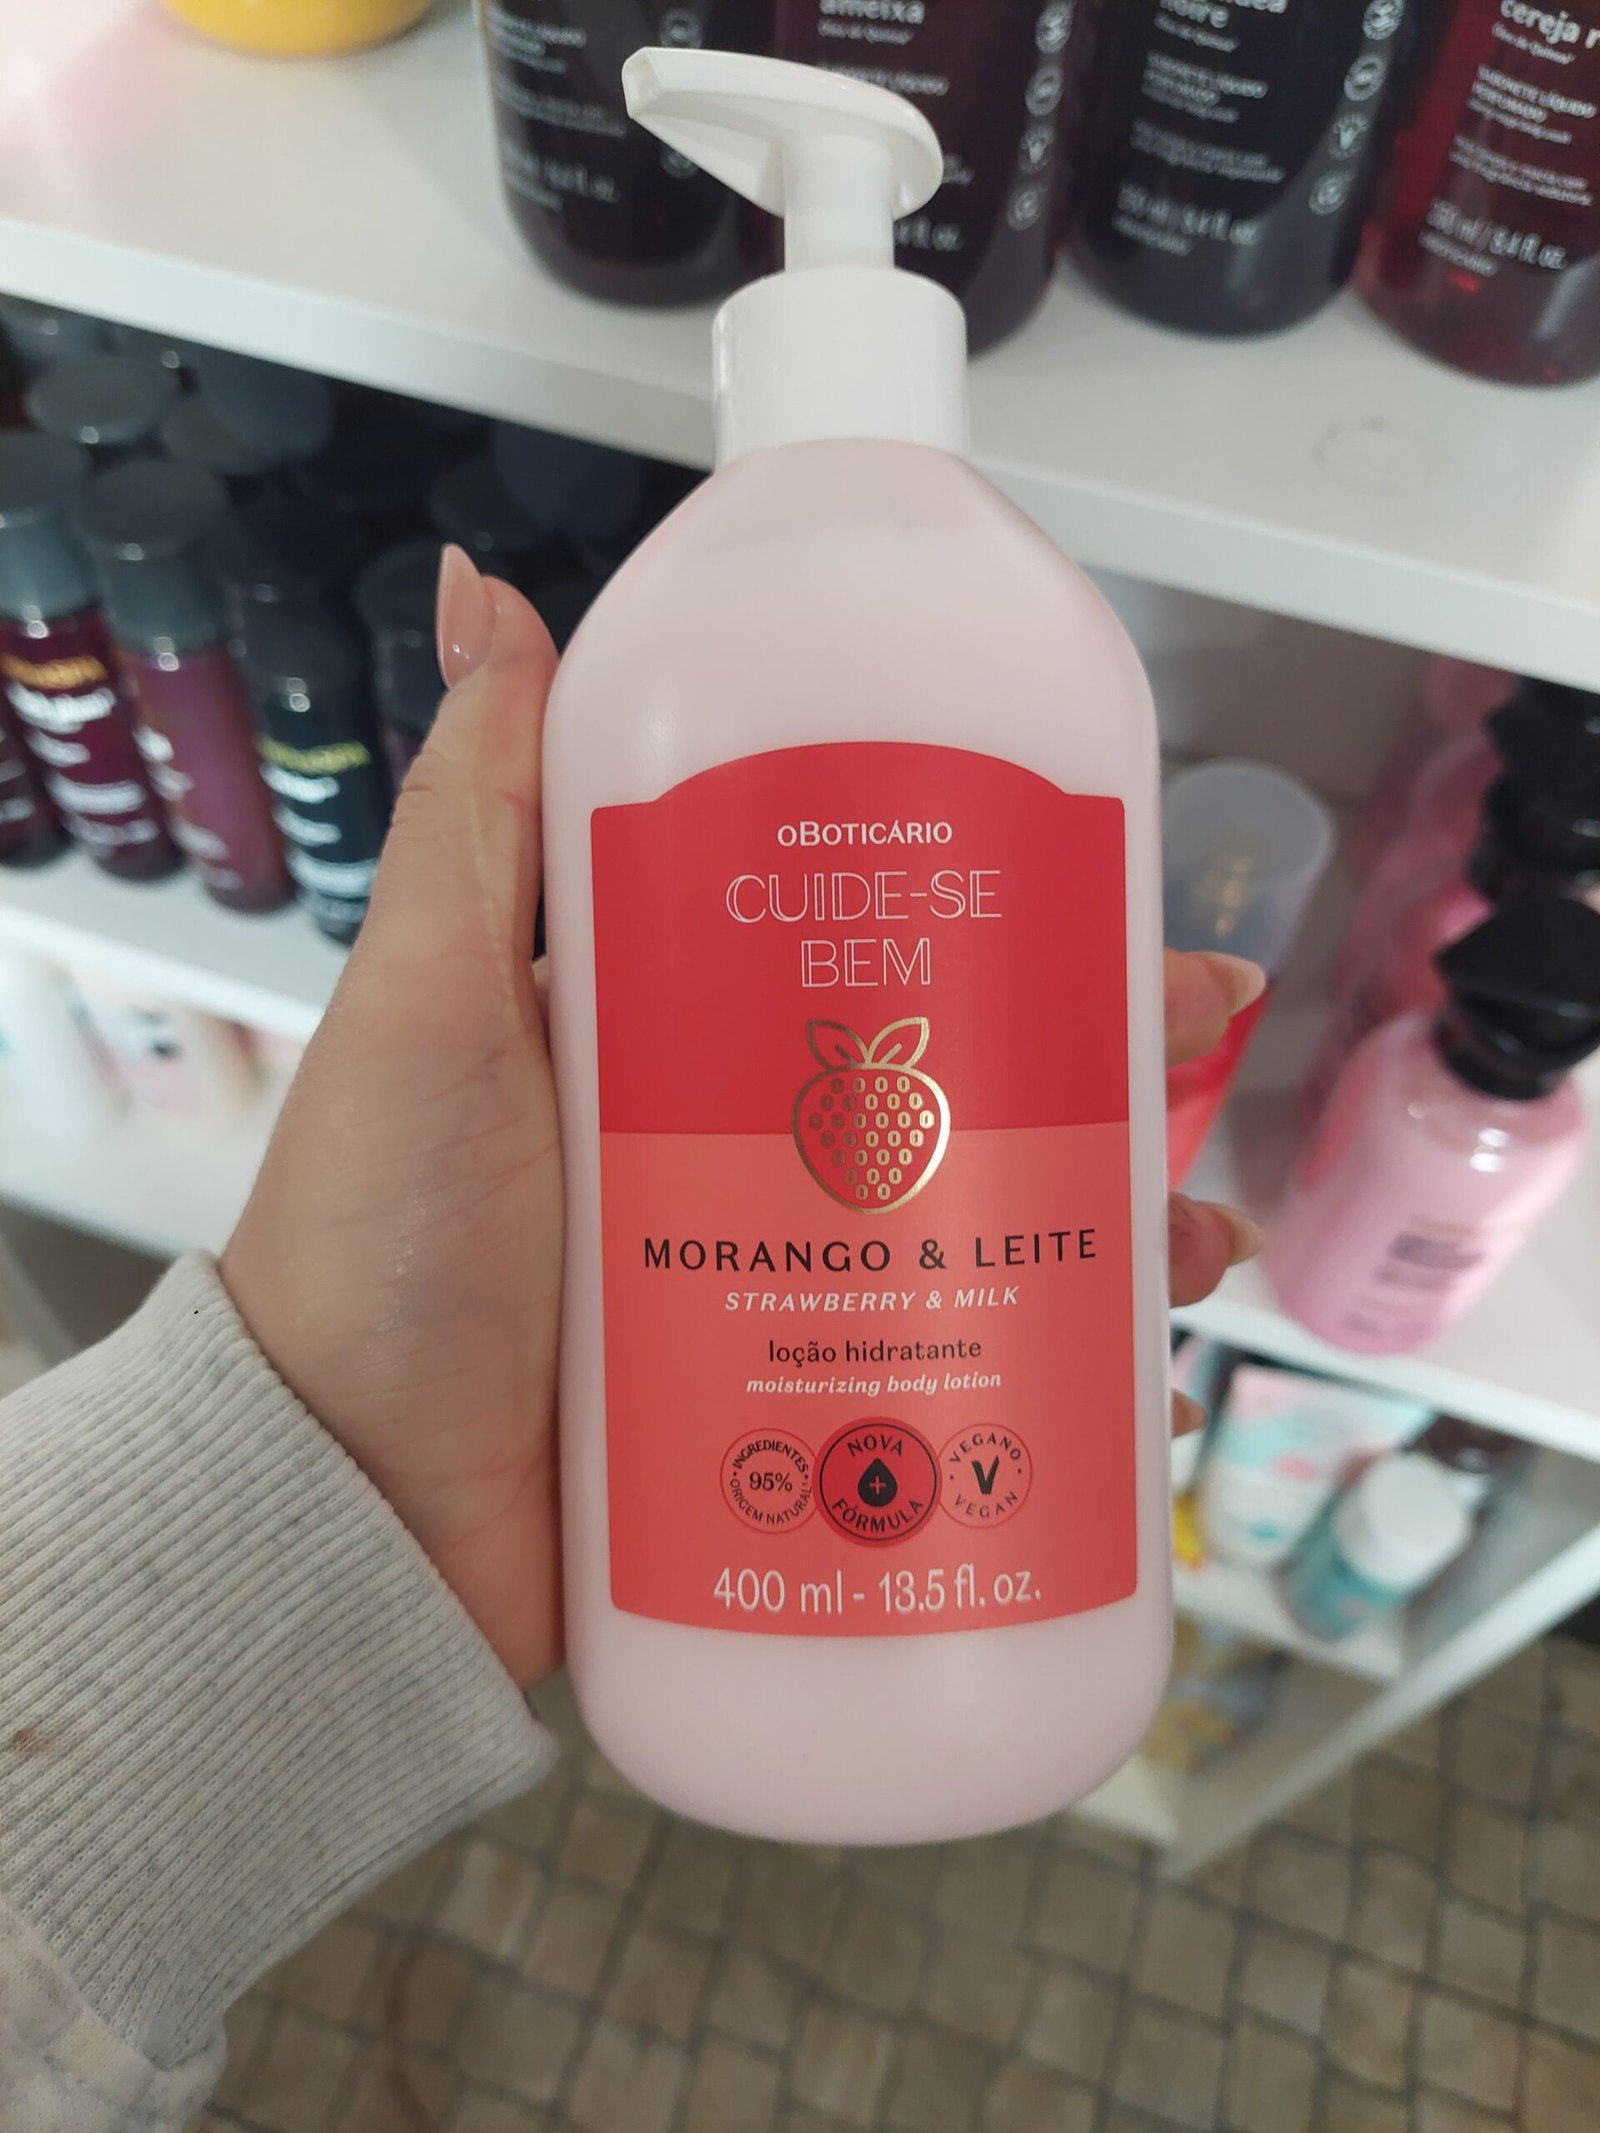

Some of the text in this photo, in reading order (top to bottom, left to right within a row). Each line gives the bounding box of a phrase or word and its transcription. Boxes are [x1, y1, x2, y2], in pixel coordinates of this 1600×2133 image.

[1501, 0, 1580, 45] cereja
[726, 869, 1002, 924] CUIDE-SE
[801, 937, 932, 988] BEM
[644, 1228, 1097, 1273] MORANGO & LEITE
[725, 1285, 1020, 1313] STRAWBERRY & MILK
[769, 1339, 982, 1369] loção hidratante
[746, 1370, 1002, 1397] moisturizing body lotion
[732, 1439, 809, 1474] INGREDIENTES
[847, 1434, 904, 1457] NOVA
[949, 1432, 1021, 1465] VEGANO
[749, 1471, 793, 1492] 95%
[730, 1479, 764, 1523] ORIGEM
[832, 1498, 924, 1532] FÓRMULA
[954, 1491, 1018, 1518] VEGAN
[713, 1562, 1042, 1615] 400 ml - 13.5 fl. oz.
